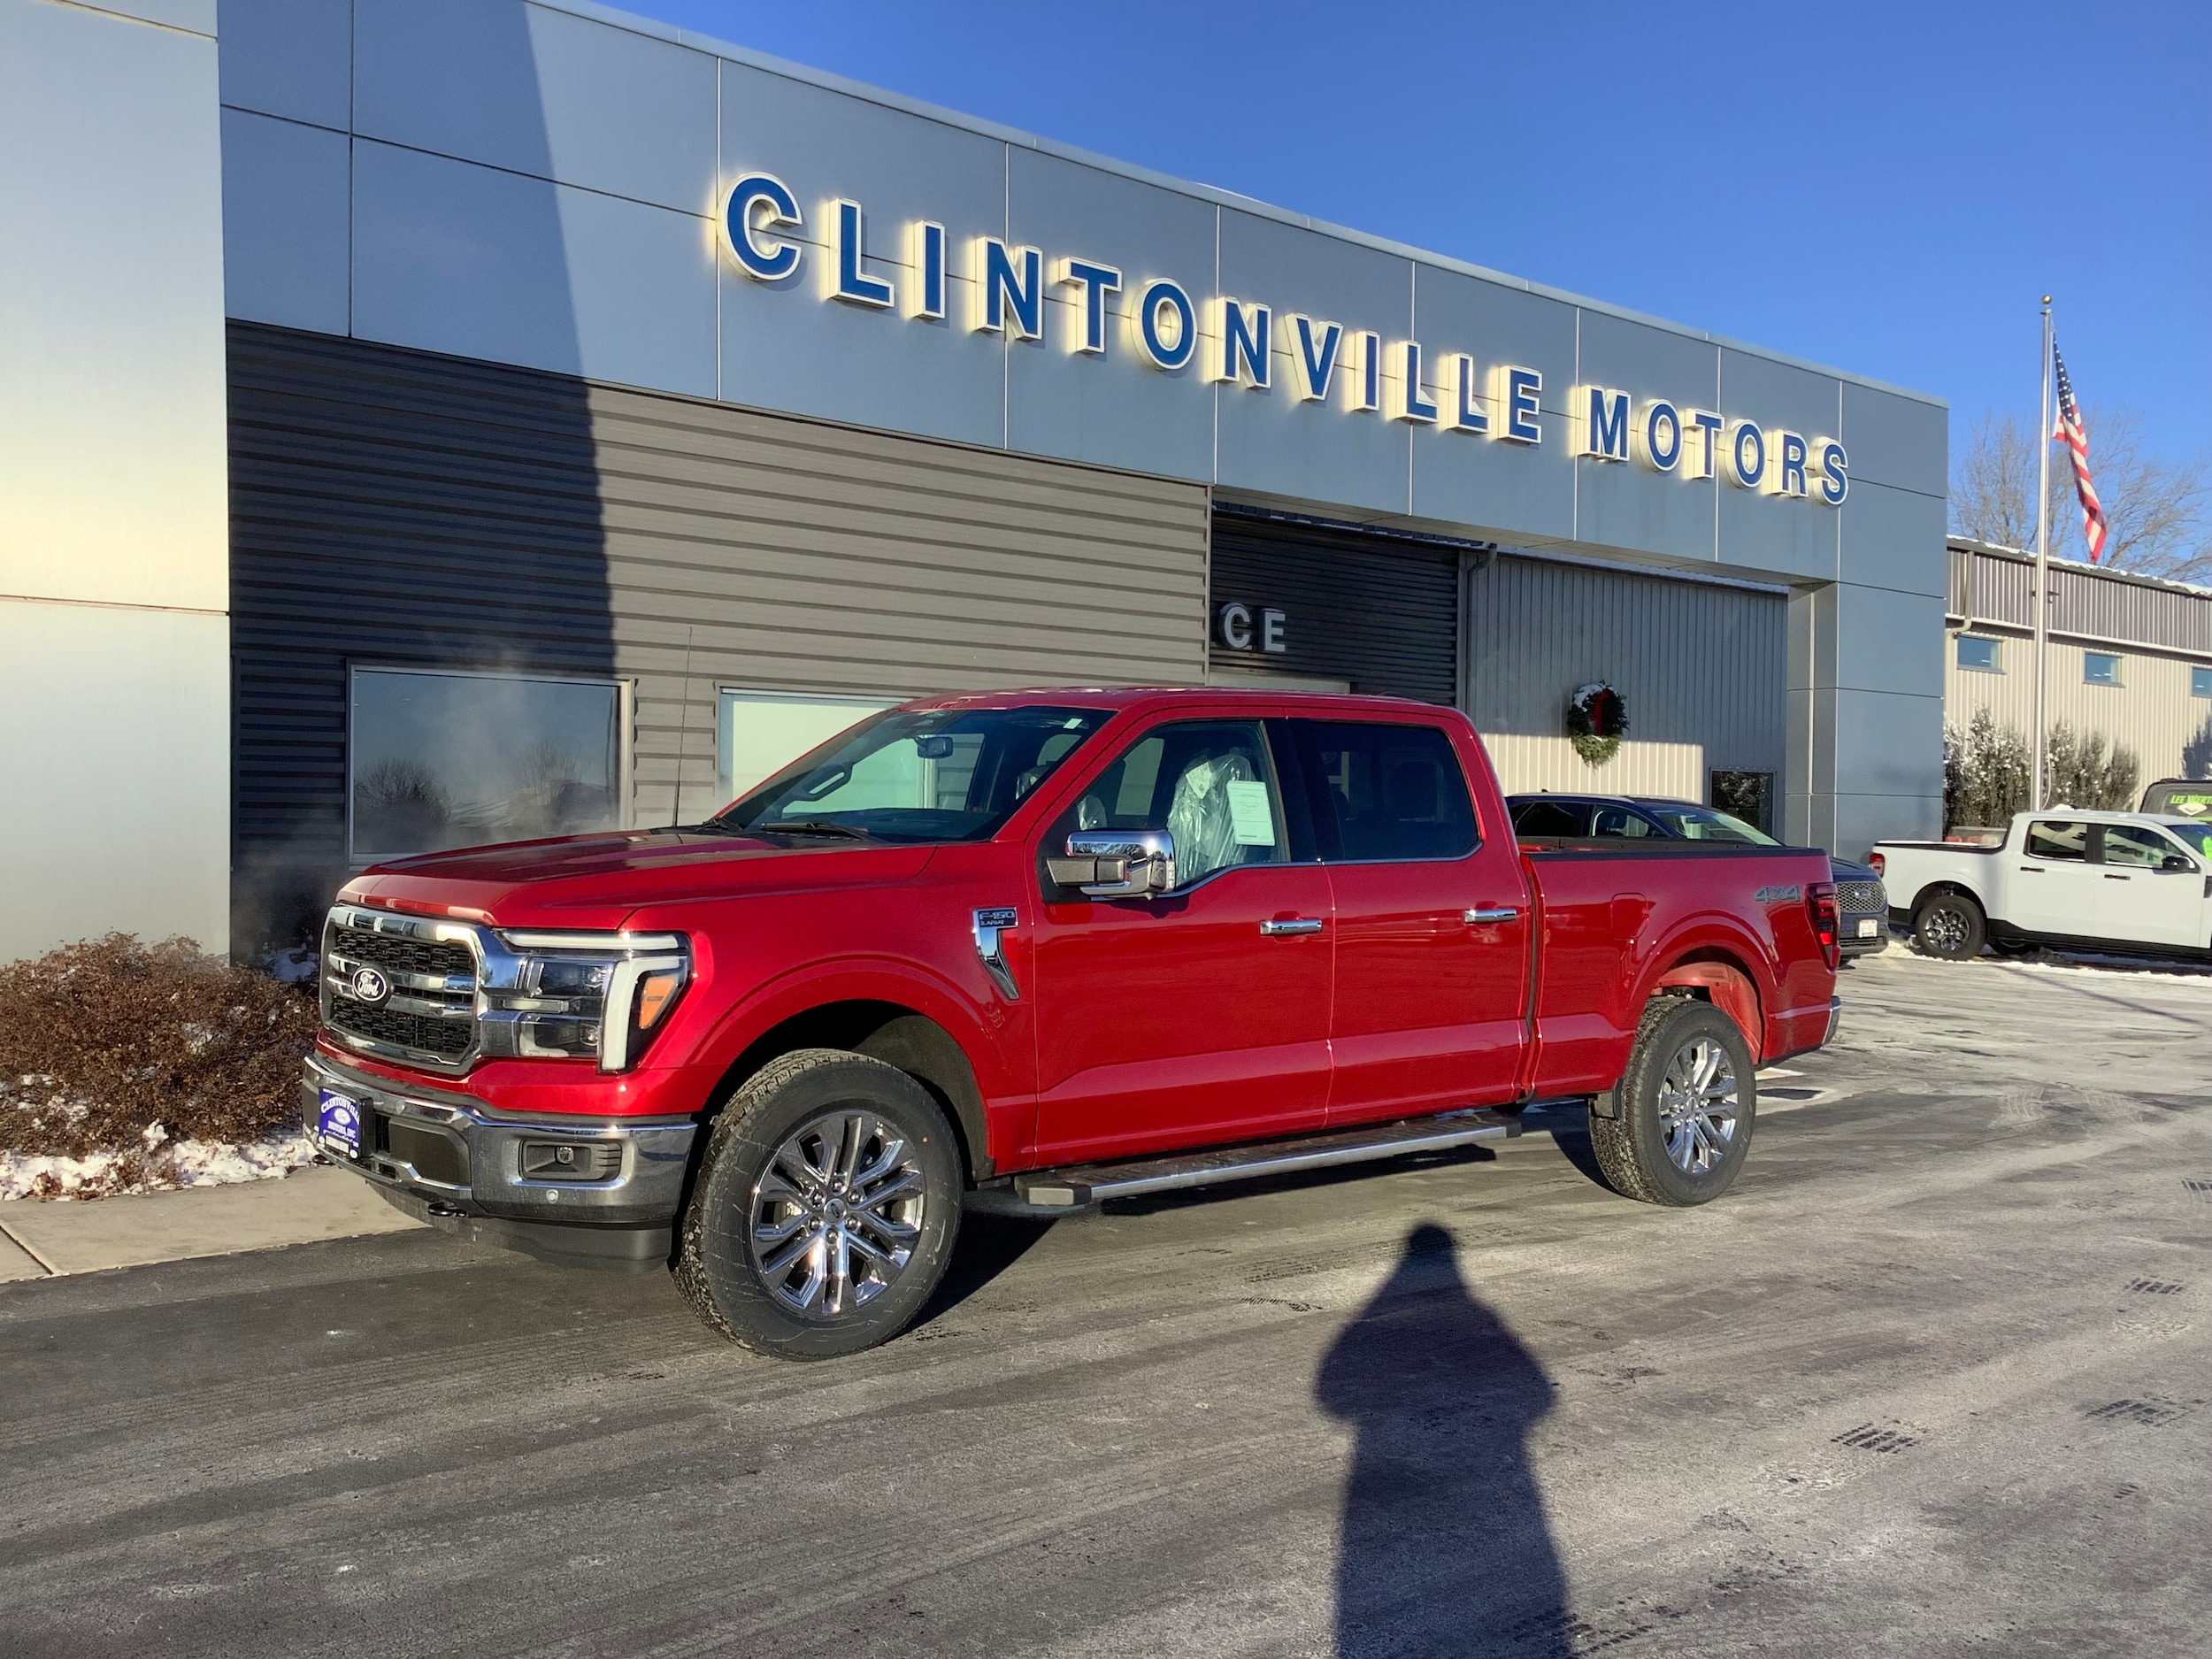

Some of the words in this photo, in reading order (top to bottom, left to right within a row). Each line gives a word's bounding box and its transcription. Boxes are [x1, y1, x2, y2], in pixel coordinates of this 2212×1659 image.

[717, 172, 1542, 445] CLINTONVILLE
[1580, 383, 1849, 507] MOTORS
[2170, 795, 2187, 804] LEE
[357, 972, 380, 997] Ford
[321, 1096, 360, 1125] CLINTONVILL
